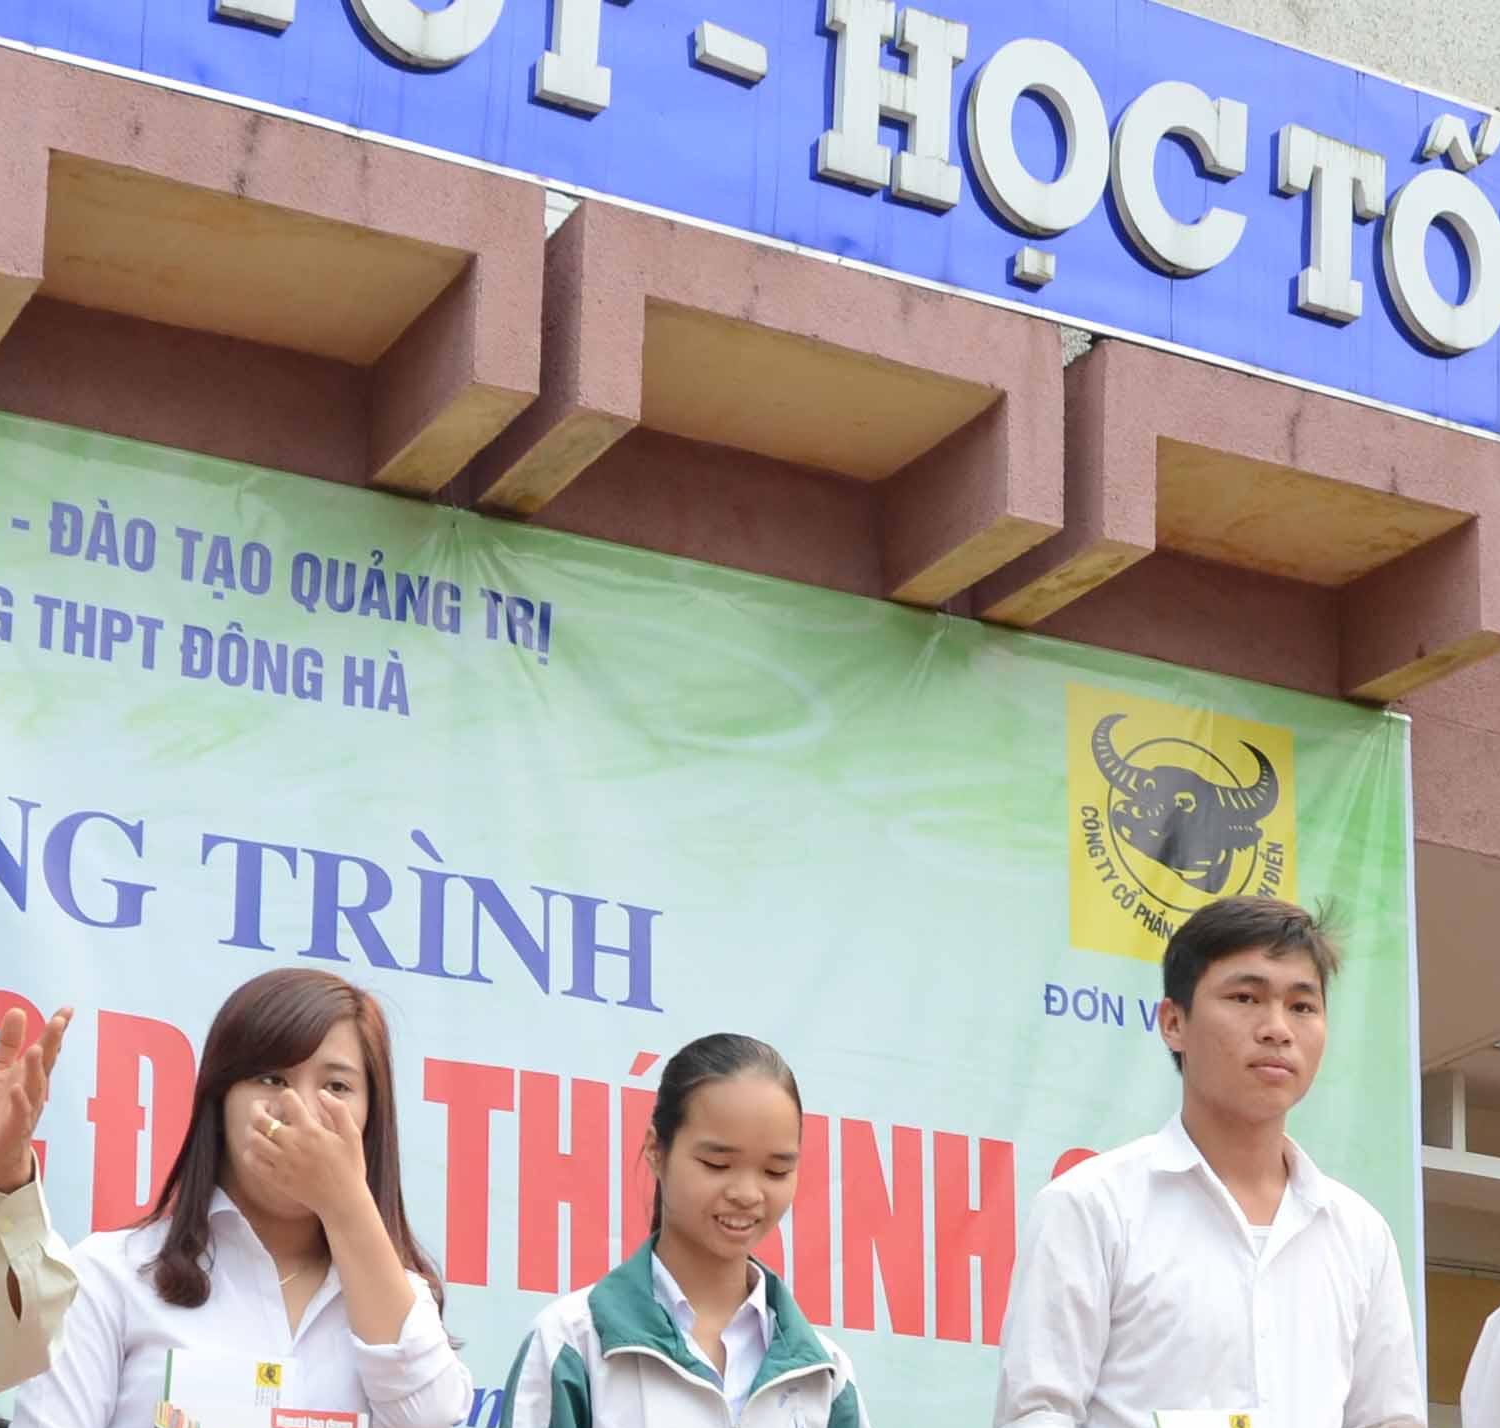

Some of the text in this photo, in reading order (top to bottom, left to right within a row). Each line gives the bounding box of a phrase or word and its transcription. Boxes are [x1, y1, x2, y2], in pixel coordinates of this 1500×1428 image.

[817, 0, 1247, 287] HỌC
[33, 594, 164, 671] THPT
[179, 621, 324, 702] ĐÔNG
[342, 649, 411, 717] HÀ
[48, 498, 157, 573] ĐÀO
[174, 525, 273, 600] TẠO
[290, 549, 462, 635] QUẢNG
[479, 586, 553, 666] TRỊ
[200, 828, 664, 1013] TRÌNH
[1080, 805, 1107, 858] CÔNG
[1096, 857, 1121, 883] TY
[1111, 883, 1144, 910] CỔ
[1044, 983, 1161, 1032] ĐƠN V
[423, 1050, 661, 1295] THÍ
[751, 1112, 1017, 1347] INH
